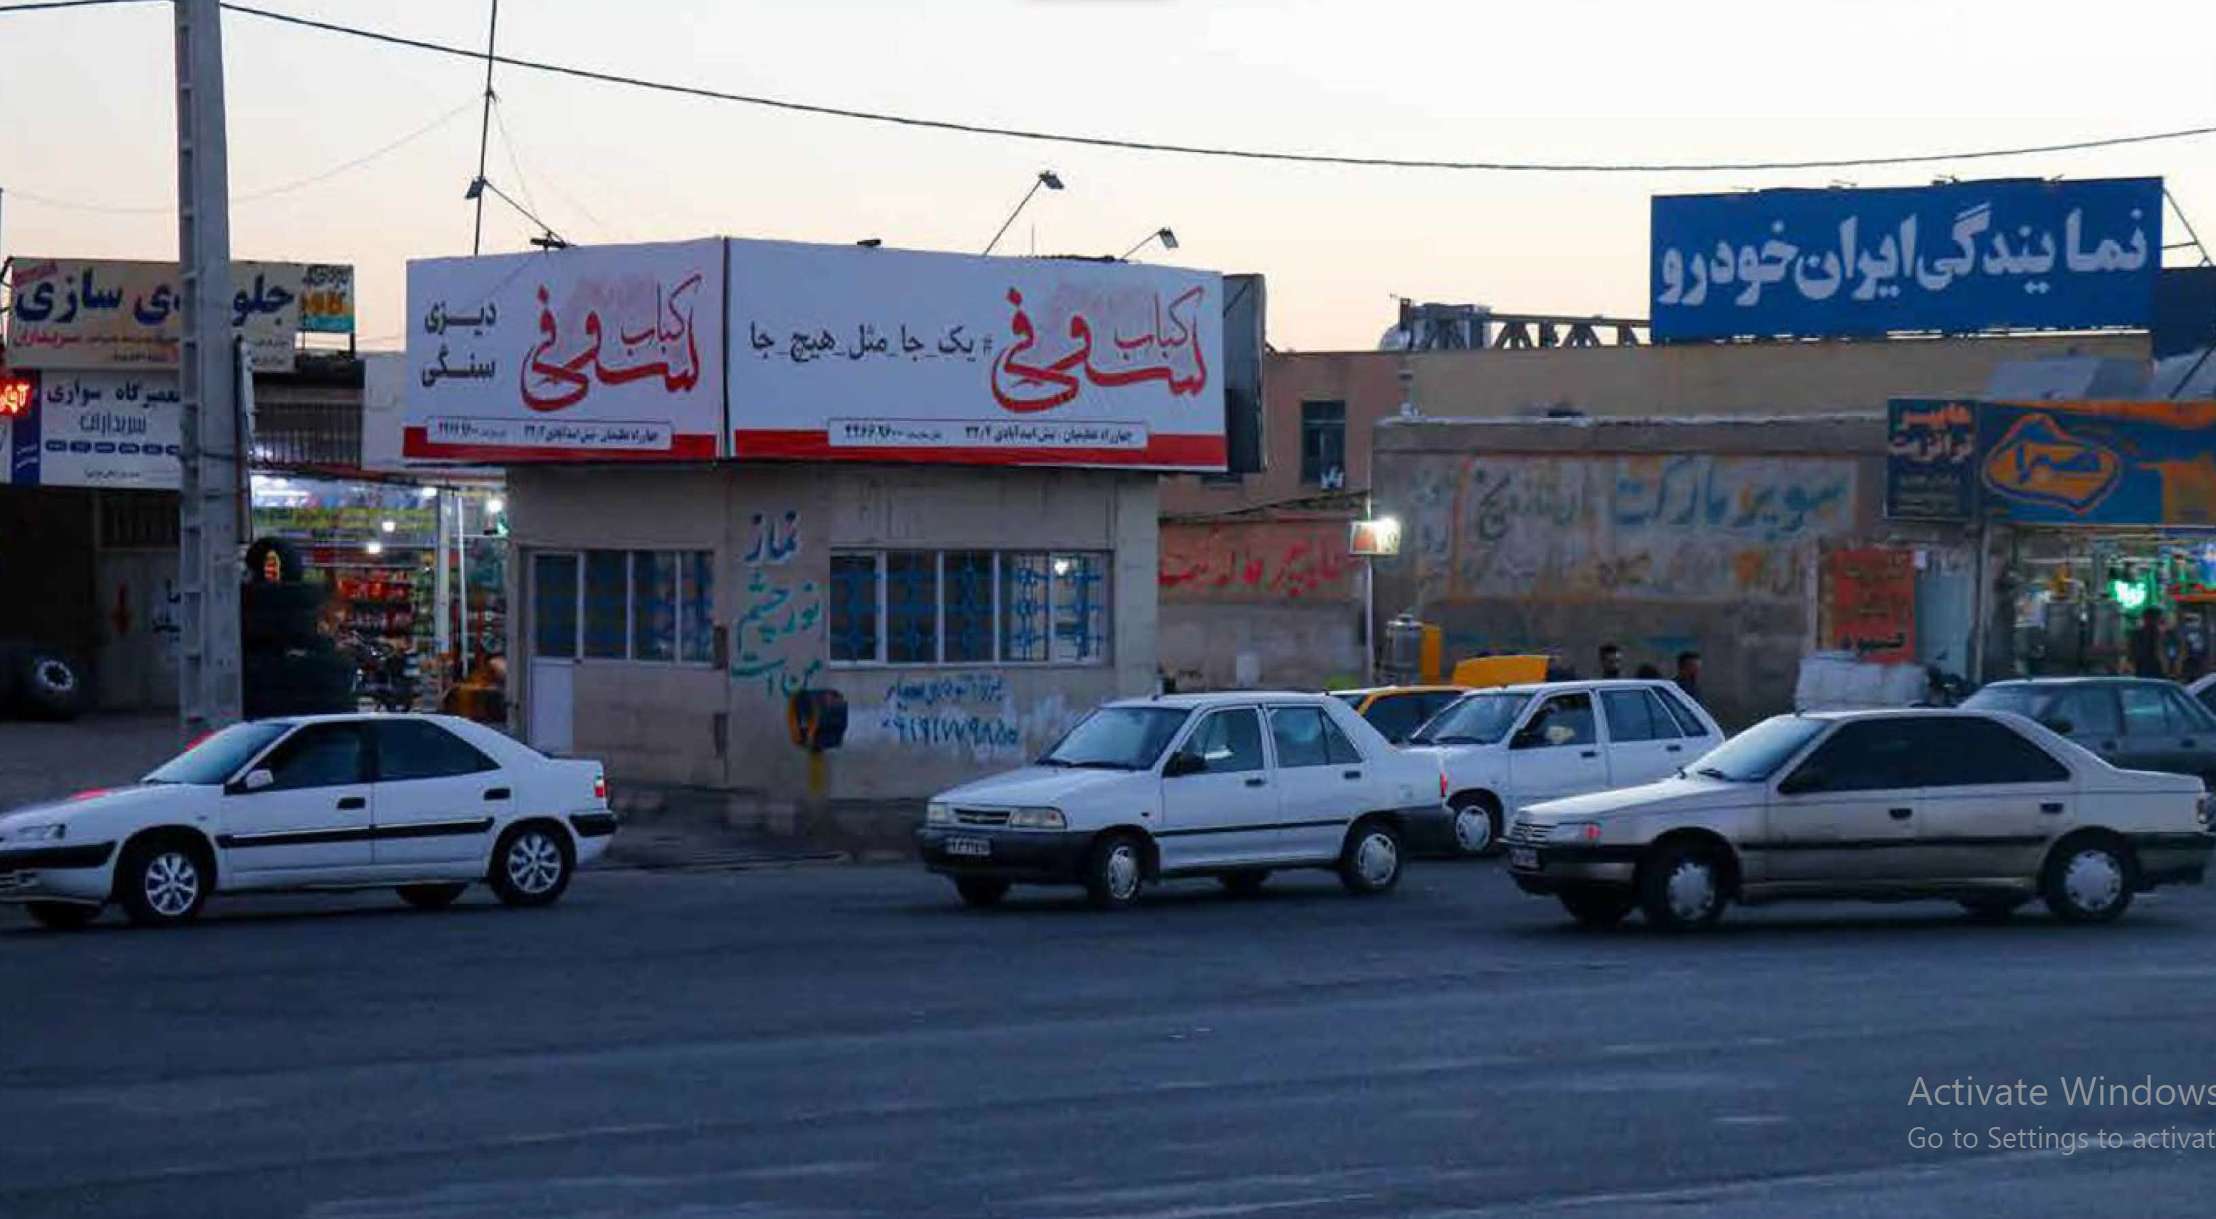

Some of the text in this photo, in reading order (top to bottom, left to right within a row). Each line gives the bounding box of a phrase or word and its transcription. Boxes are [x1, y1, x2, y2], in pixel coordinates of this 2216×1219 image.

[1657, 220, 1798, 306] خودرو
[1795, 214, 1919, 300] ایران
[15, 266, 124, 323] سازی
[425, 302, 497, 336] دیزی
[620, 273, 702, 356] کباب
[1114, 285, 1205, 360] کباب
[47, 378, 102, 408] سواری
[422, 344, 496, 387] سنگی
[744, 510, 798, 564] نماز
